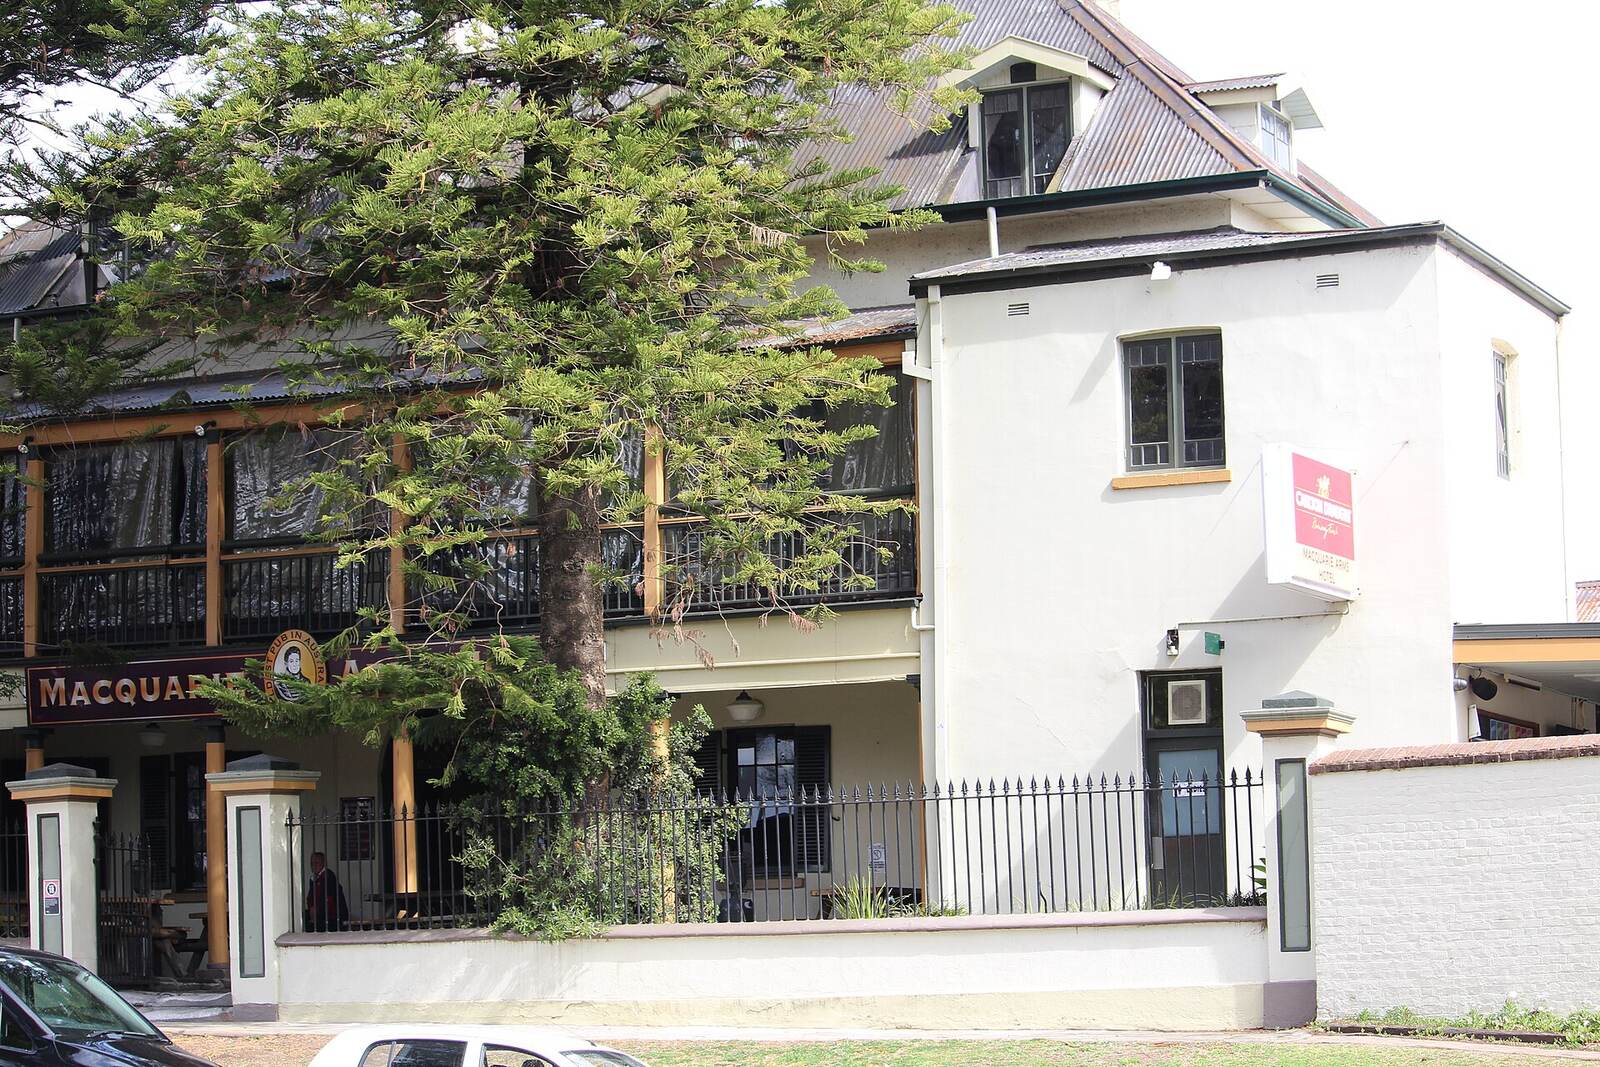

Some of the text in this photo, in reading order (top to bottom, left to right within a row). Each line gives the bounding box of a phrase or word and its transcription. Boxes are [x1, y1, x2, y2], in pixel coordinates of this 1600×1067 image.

[269, 633, 288, 656] PUB
[290, 631, 303, 640] IN
[303, 637, 325, 684] AUSTRA
[265, 656, 275, 699] LDEST
